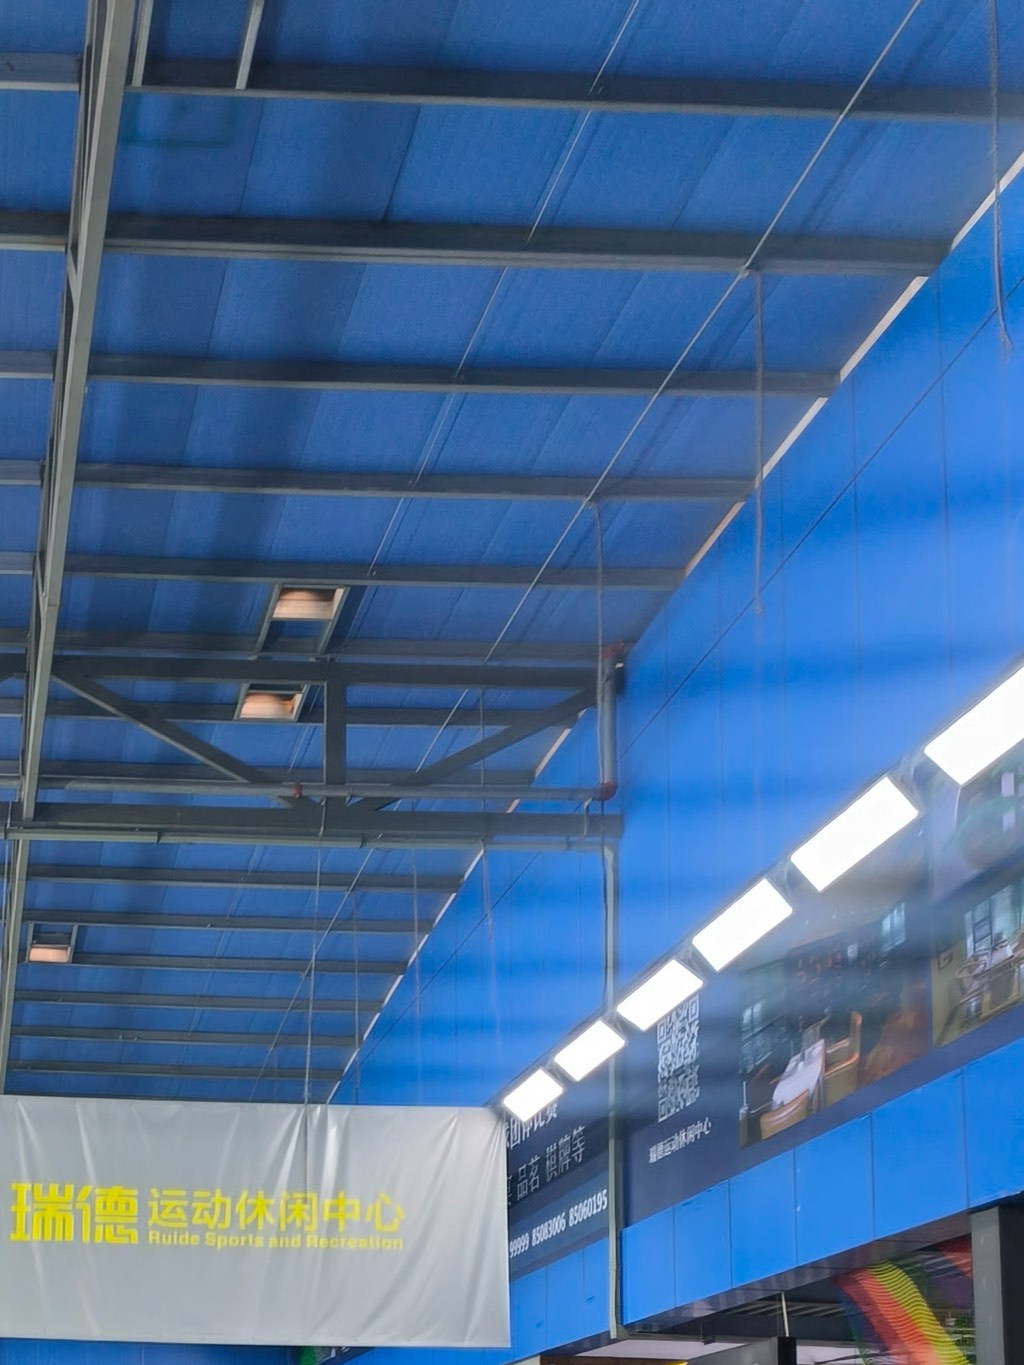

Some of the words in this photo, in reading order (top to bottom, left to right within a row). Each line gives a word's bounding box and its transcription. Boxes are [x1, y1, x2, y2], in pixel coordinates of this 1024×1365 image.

[545, 1125, 586, 1183] 棋牌等
[9, 1183, 139, 1245] 瑞德
[147, 1187, 405, 1233] 运动休闲中心
[148, 1230, 200, 1247] Ruide
[204, 1231, 263, 1249] Sports
[268, 1233, 302, 1248] and
[306, 1233, 404, 1250] Recreation
[531, 1212, 566, 1246] 85083006
[568, 1189, 608, 1227] 85060195
